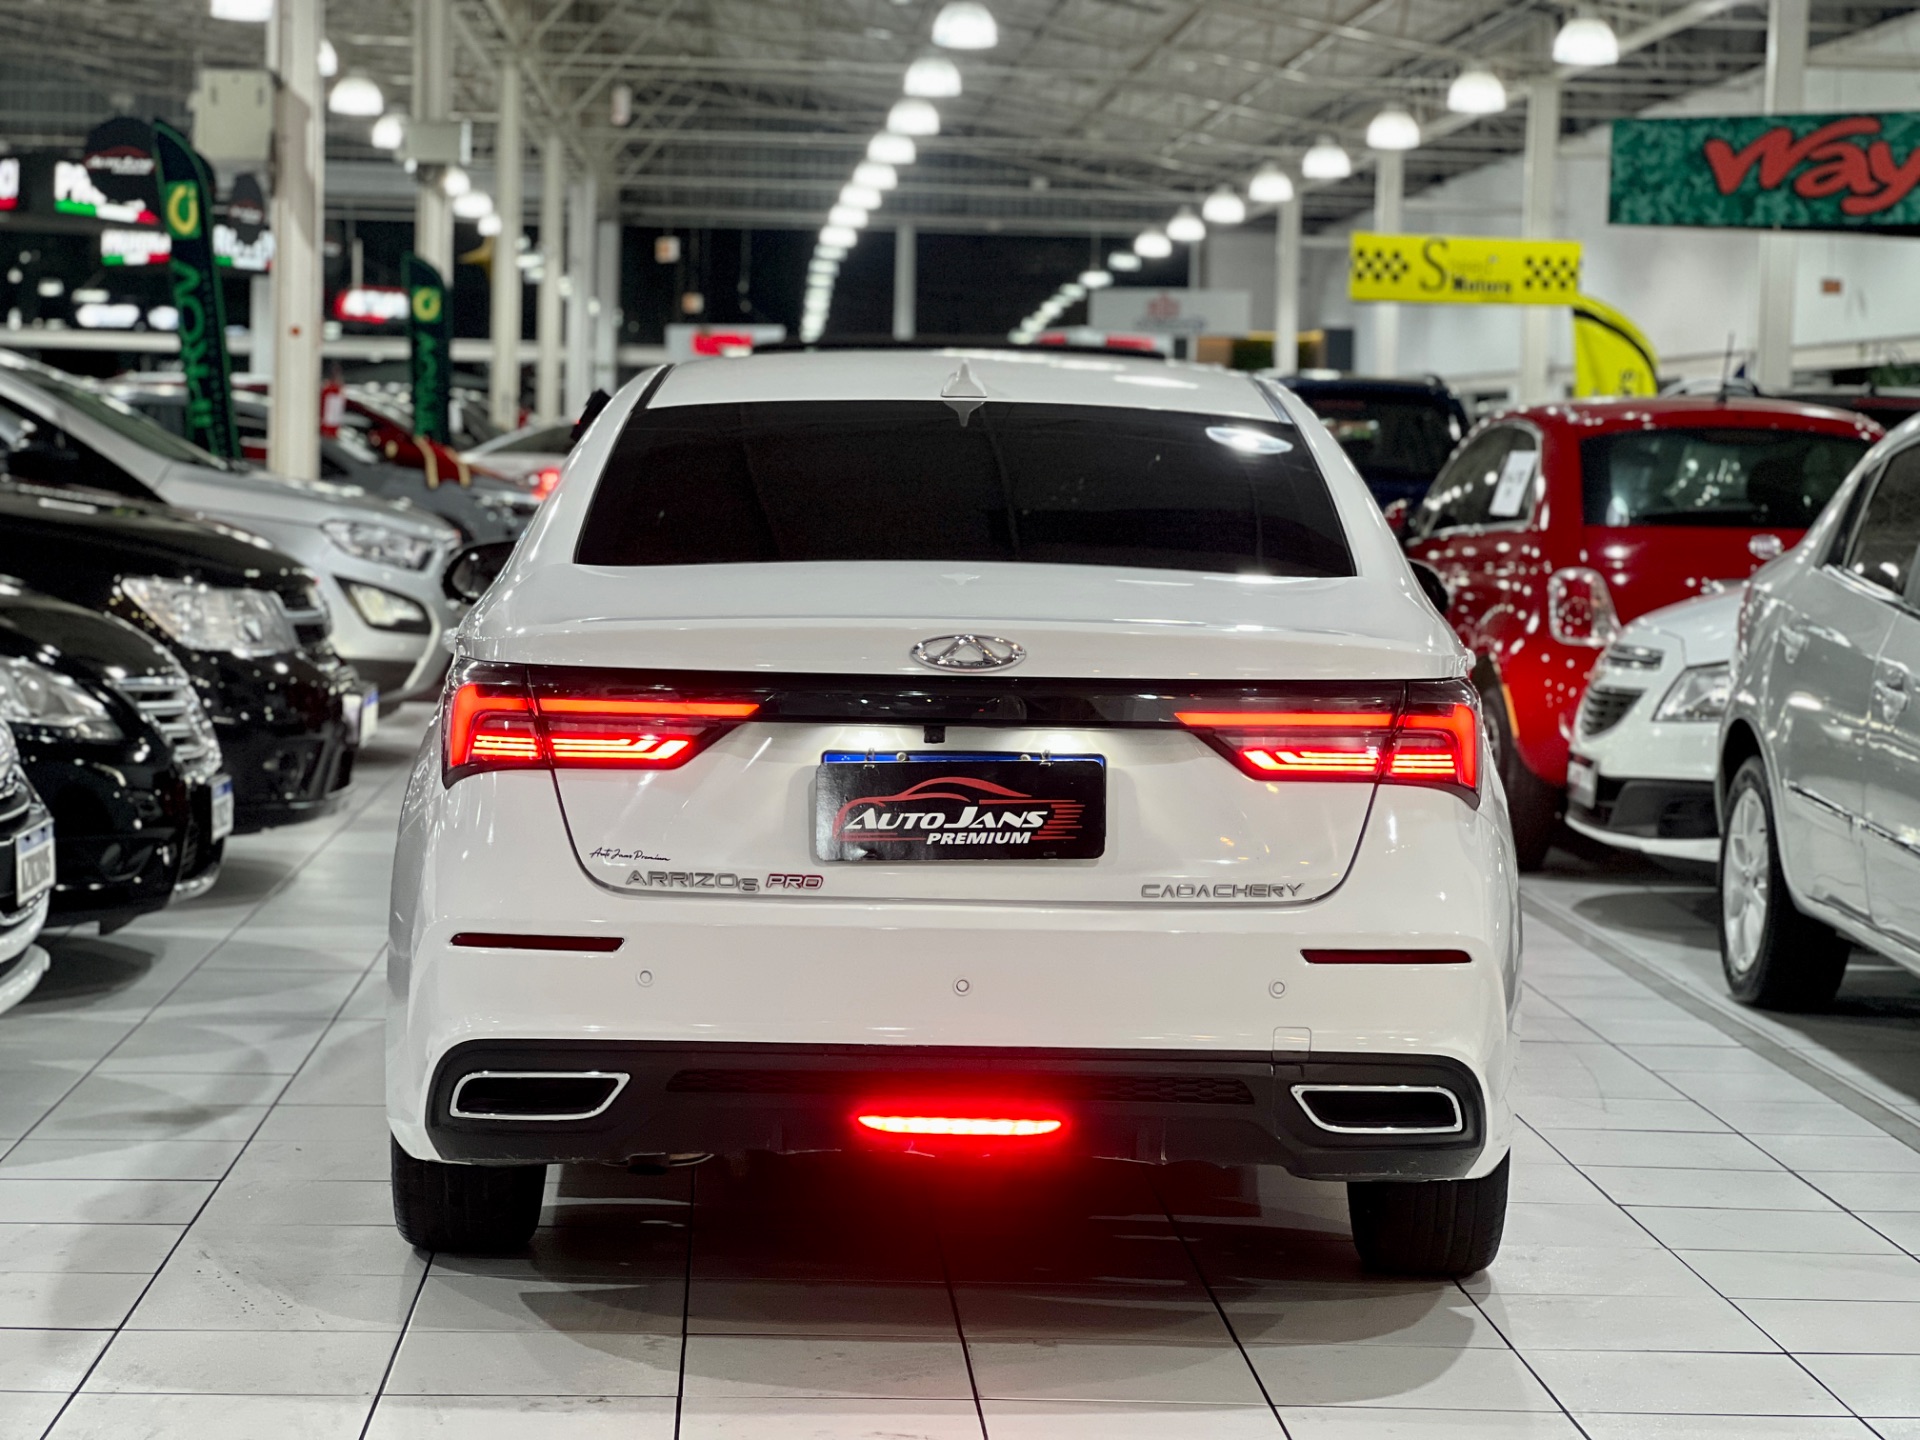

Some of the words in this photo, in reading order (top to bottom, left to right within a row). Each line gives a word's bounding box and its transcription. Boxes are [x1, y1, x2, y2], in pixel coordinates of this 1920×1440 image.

[1704, 116, 1920, 215] Way
[845, 807, 939, 830] AUTO
[944, 806, 1048, 830] JANS
[926, 831, 1032, 845] PREMIUM
[766, 873, 824, 890] PRO
